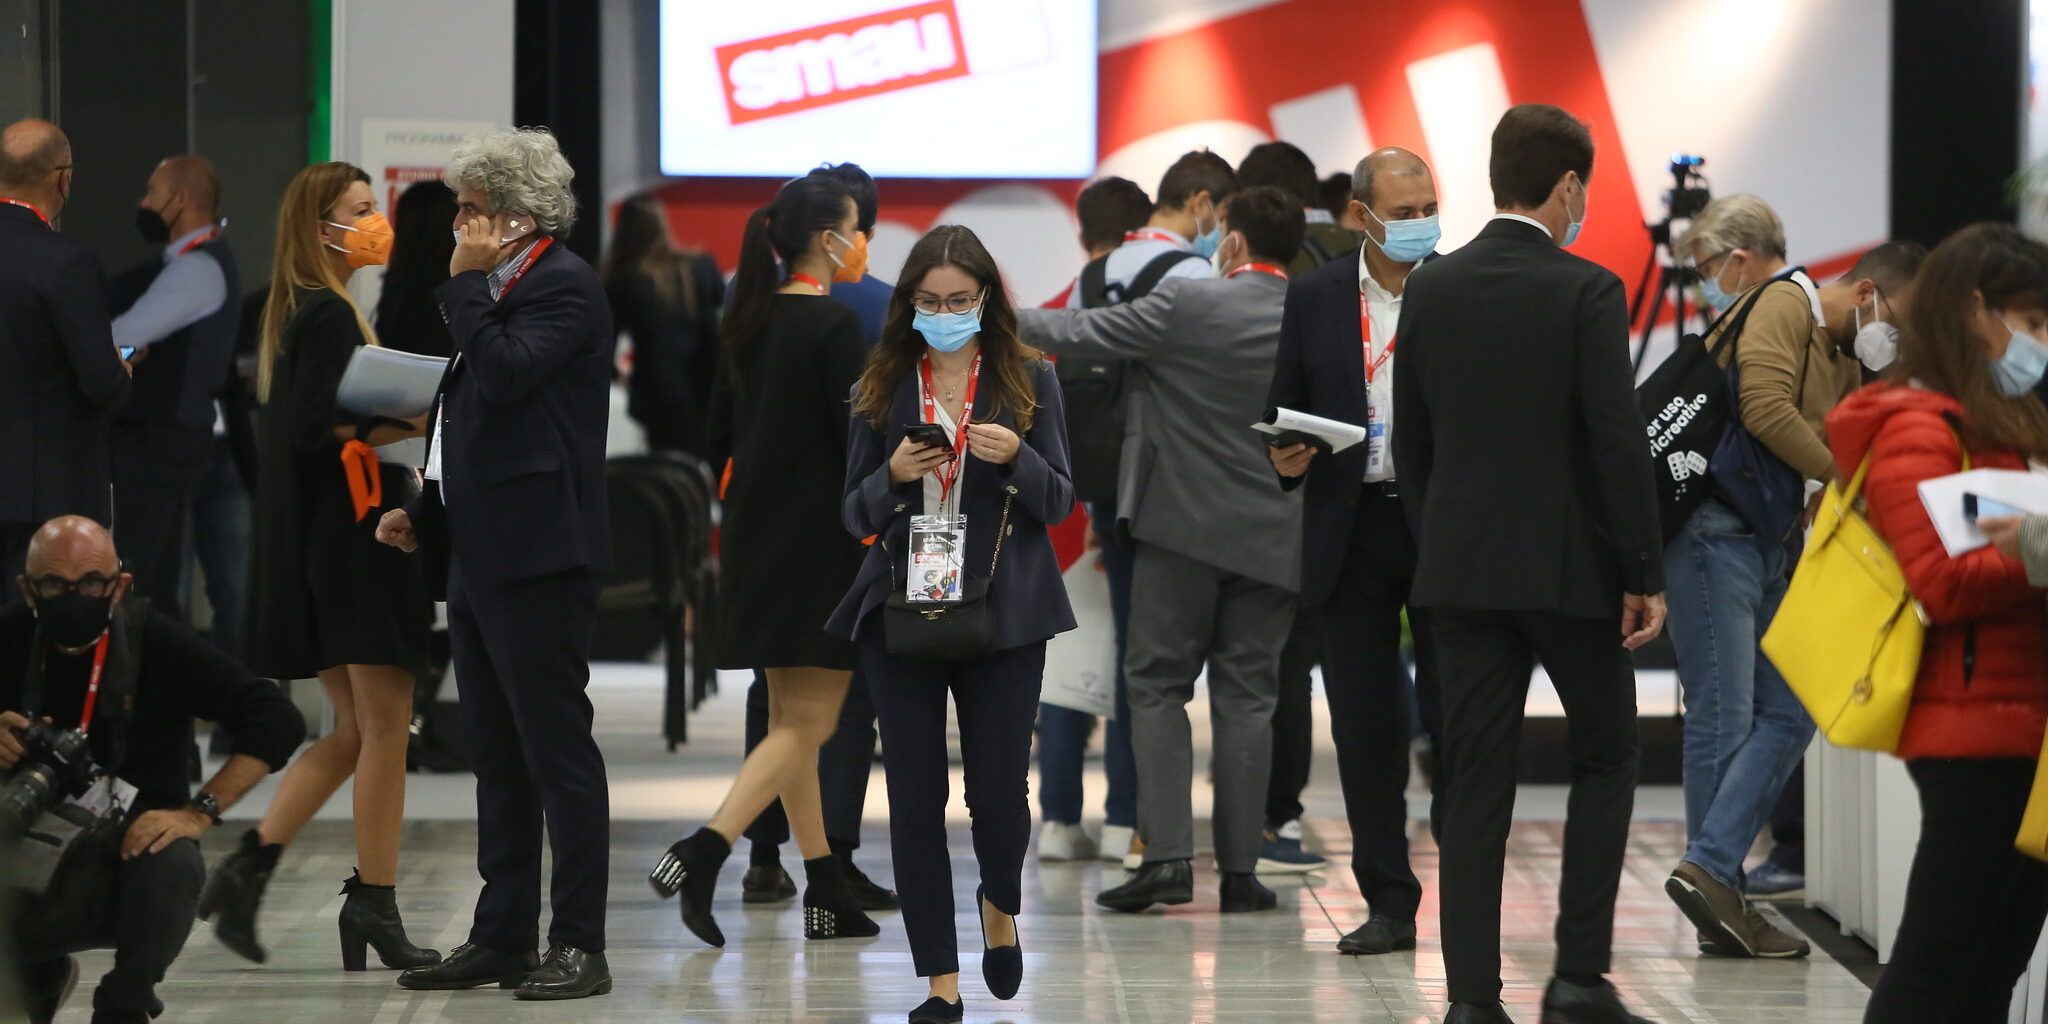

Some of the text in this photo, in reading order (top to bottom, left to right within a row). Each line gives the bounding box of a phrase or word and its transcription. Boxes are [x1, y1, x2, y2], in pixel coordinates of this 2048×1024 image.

[727, 11, 957, 111] smau
[1646, 396, 1685, 438] er uso
